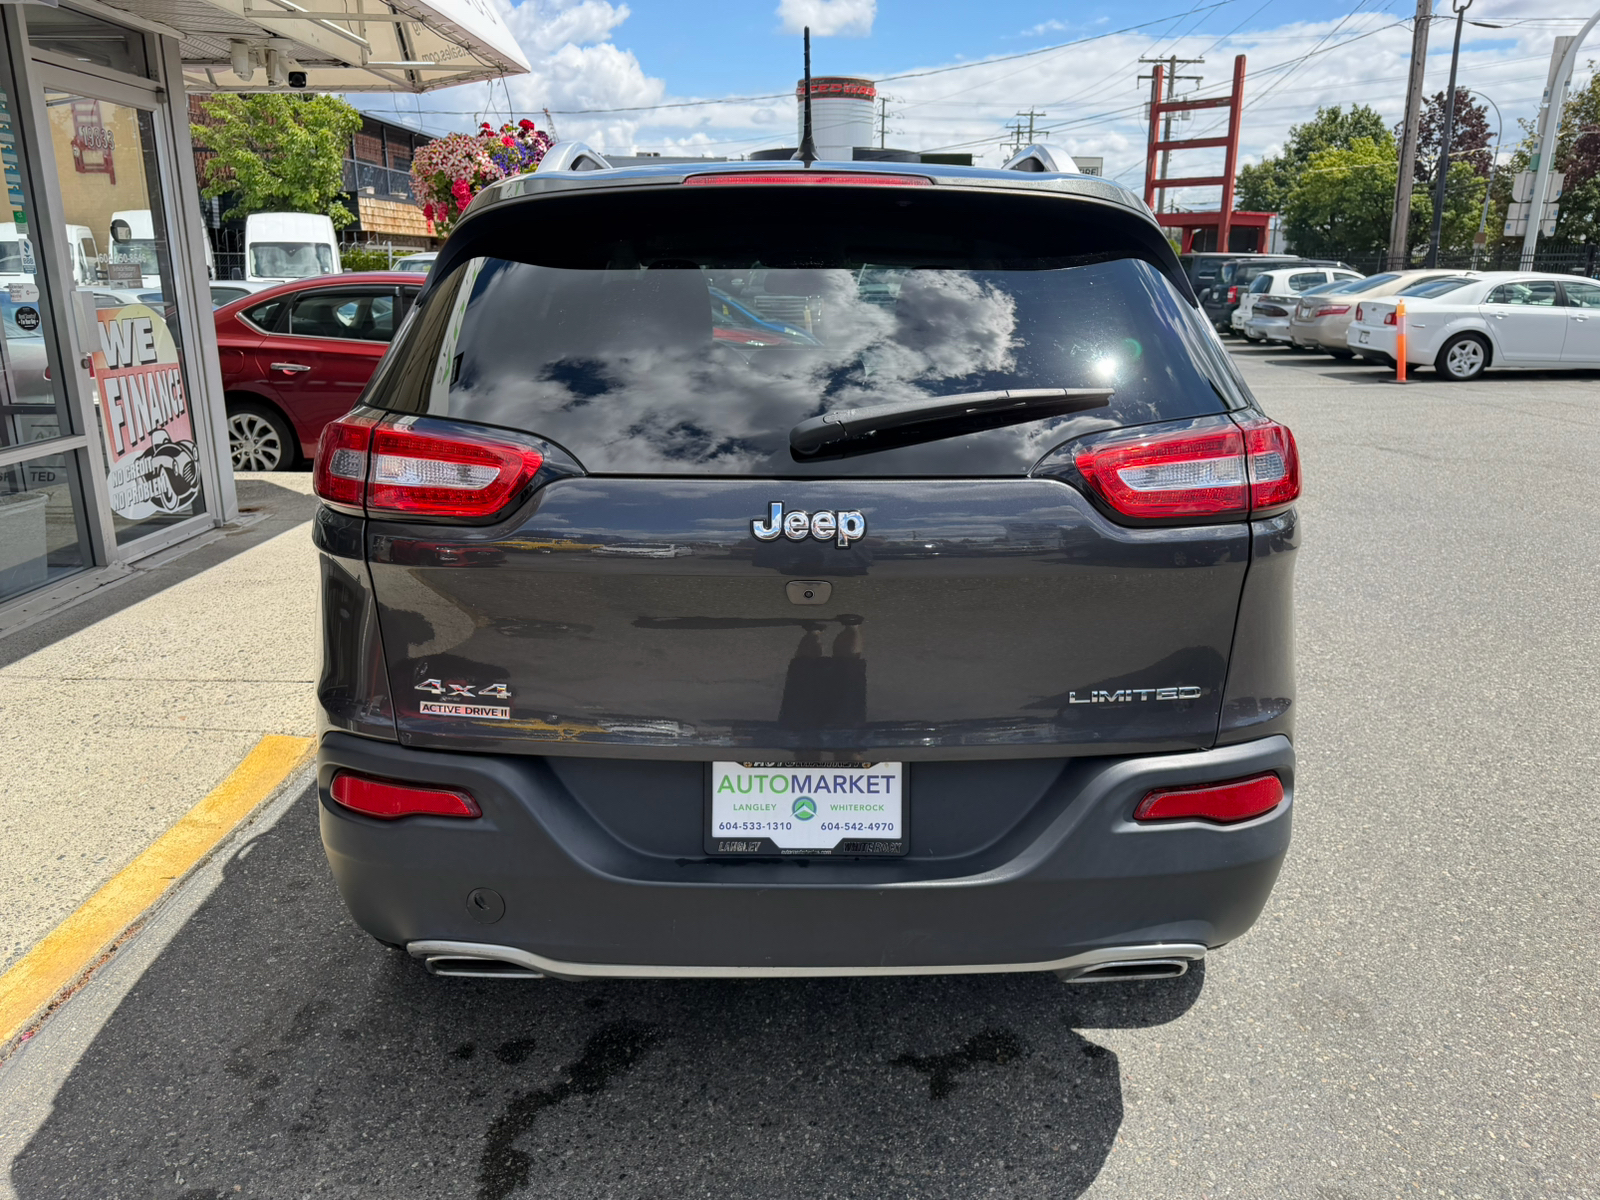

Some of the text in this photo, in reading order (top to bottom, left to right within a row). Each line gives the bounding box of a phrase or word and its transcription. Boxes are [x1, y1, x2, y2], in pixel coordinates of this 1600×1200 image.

[98, 316, 157, 369] WE
[103, 368, 185, 456] FINANCE
[112, 469, 124, 488] NO
[113, 491, 126, 511] NO
[750, 500, 867, 550] Jeep
[414, 678, 512, 699] 4x4
[1068, 685, 1202, 704] LIMITED
[422, 703, 461, 715] ACTIVE
[465, 707, 498, 717] DRIVE
[716, 774, 896, 795] AUTOMARKET
[732, 803, 885, 812] LANGLEY WHITEROCK
[718, 821, 895, 832] 604-533-1310 604-542-4970
[717, 841, 762, 852] LANGLEY
